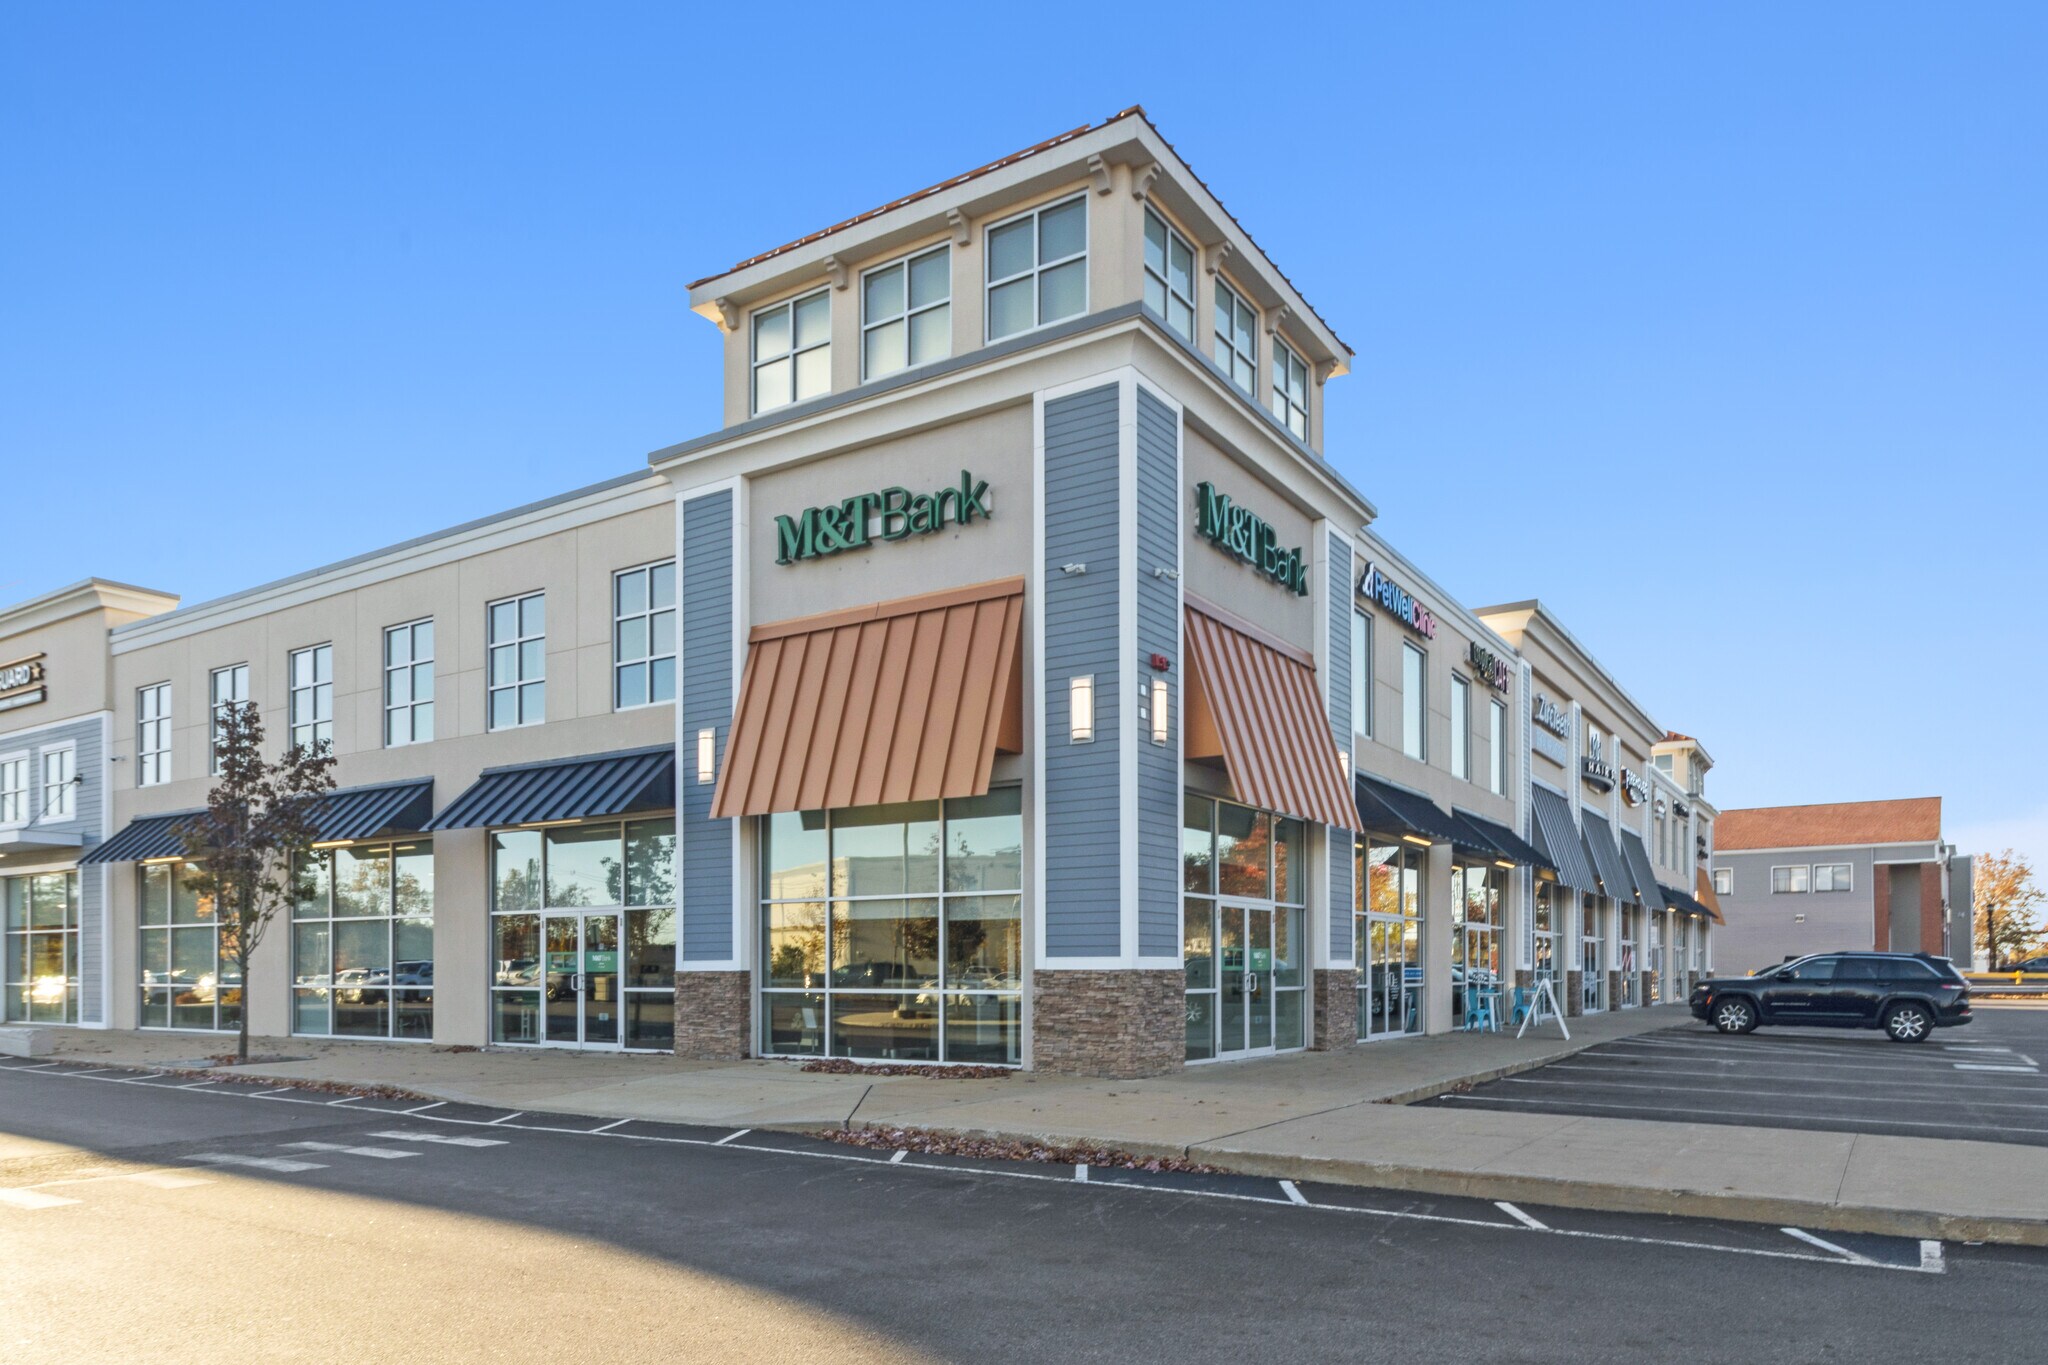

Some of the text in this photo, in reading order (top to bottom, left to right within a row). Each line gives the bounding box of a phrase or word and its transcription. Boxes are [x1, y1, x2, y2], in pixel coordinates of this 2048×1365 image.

[774, 469, 990, 566] M&T Bank
[1197, 481, 1308, 597] M&T Bank
